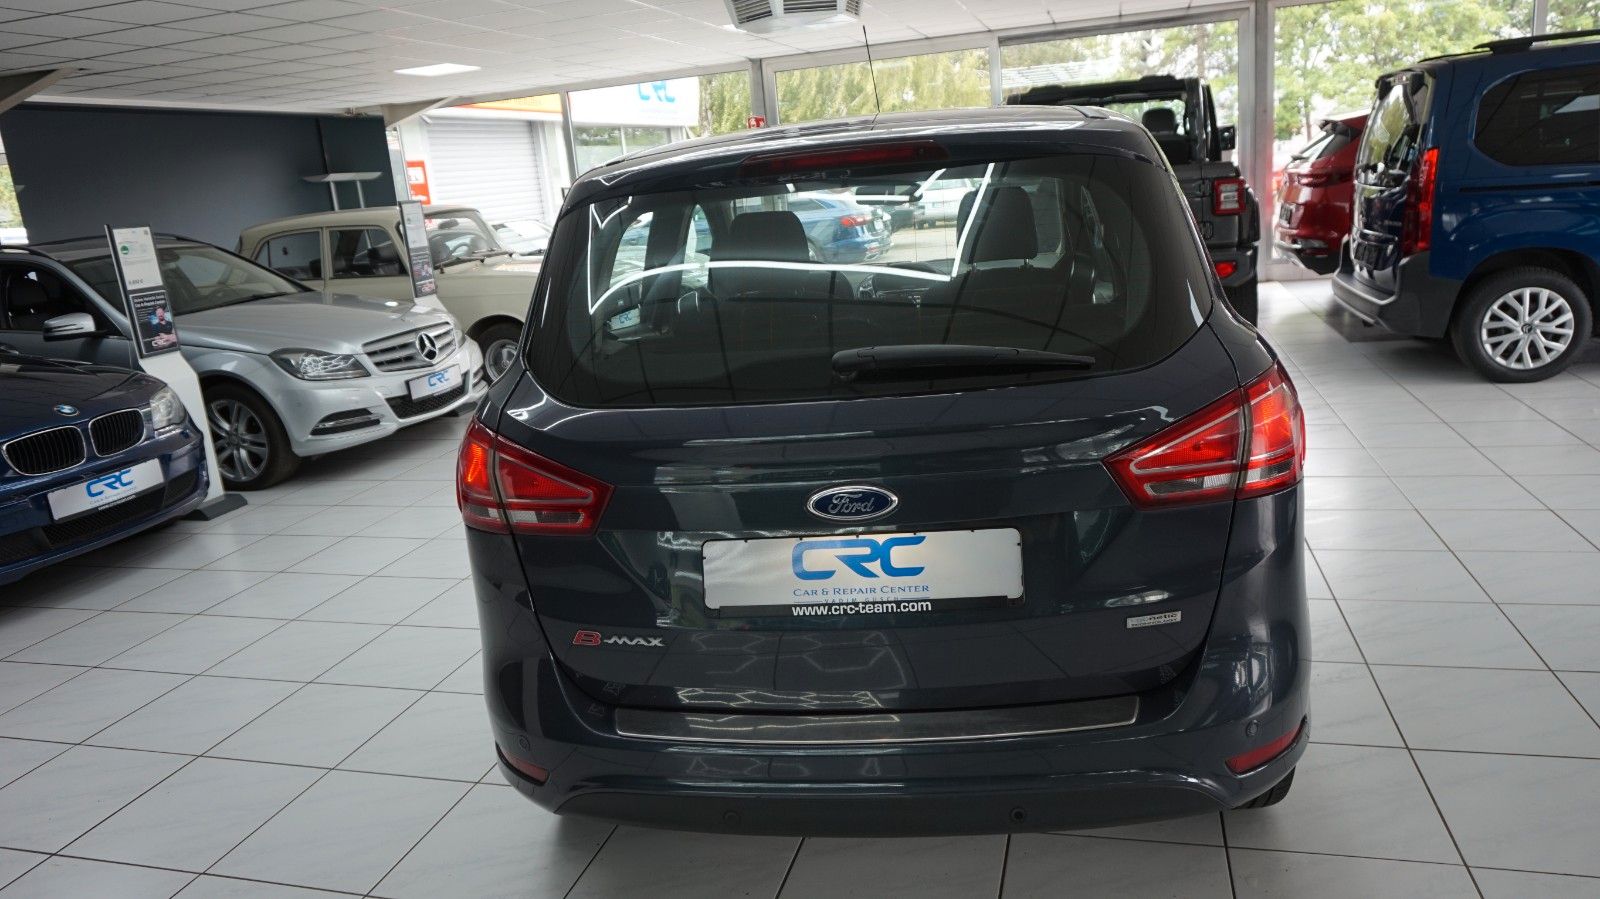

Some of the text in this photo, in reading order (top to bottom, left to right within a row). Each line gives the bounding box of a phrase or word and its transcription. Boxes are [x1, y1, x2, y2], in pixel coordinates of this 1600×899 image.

[85, 468, 134, 497] CRC
[826, 492, 877, 514] Ford
[791, 535, 927, 580] CRC
[821, 588, 829, 596] &
[791, 601, 932, 616] www.crc-team.com
[572, 630, 666, 647] B-MAX
